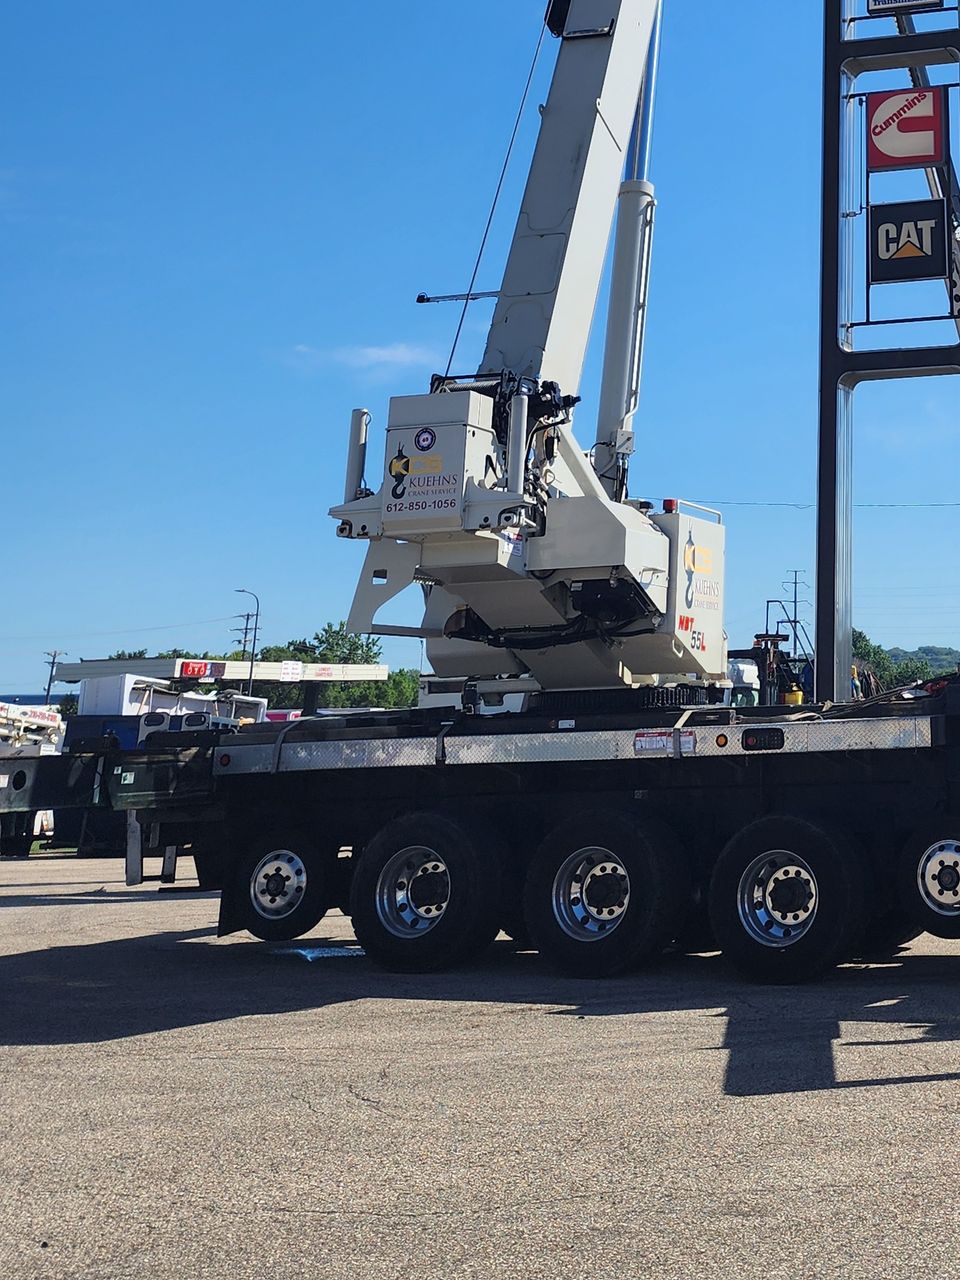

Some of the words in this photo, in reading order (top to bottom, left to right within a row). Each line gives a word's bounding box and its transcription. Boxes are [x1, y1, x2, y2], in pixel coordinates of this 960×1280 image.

[871, 92, 928, 137] Cummins
[877, 219, 937, 260] CAT
[386, 499, 456, 513] 612-850-1056
[678, 615, 695, 631] NBT
[690, 630, 706, 651] 55L
